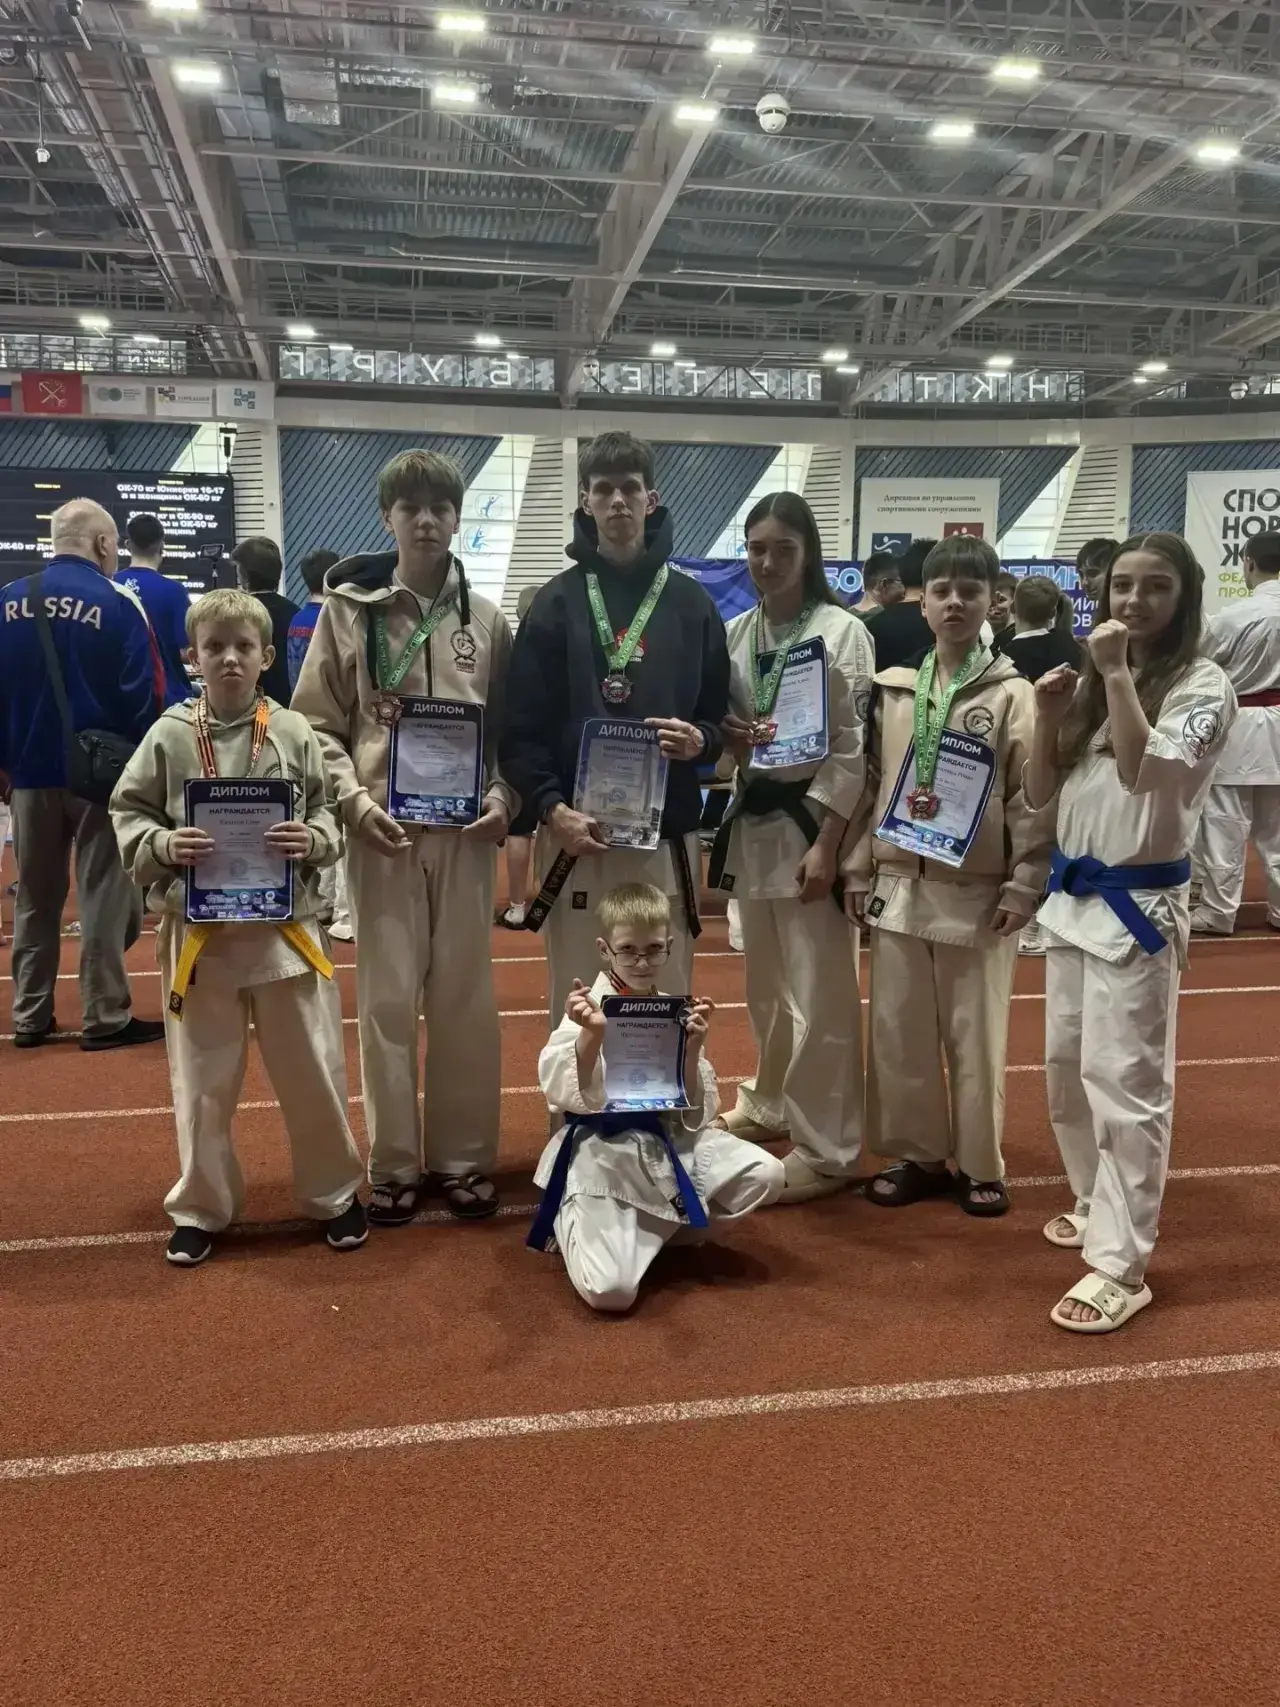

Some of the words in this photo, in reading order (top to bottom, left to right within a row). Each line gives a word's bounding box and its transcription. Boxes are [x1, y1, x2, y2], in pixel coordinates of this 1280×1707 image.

[786, 647, 812, 663] ПЛОМ
[412, 703, 464, 715] ДИПЛОМ
[598, 724, 655, 740] ДИПЛОМ
[941, 735, 982, 755] ИПЛОМ
[210, 786, 270, 798] ДИПЛОМ
[620, 1002, 671, 1013] ДИПЛОМ
